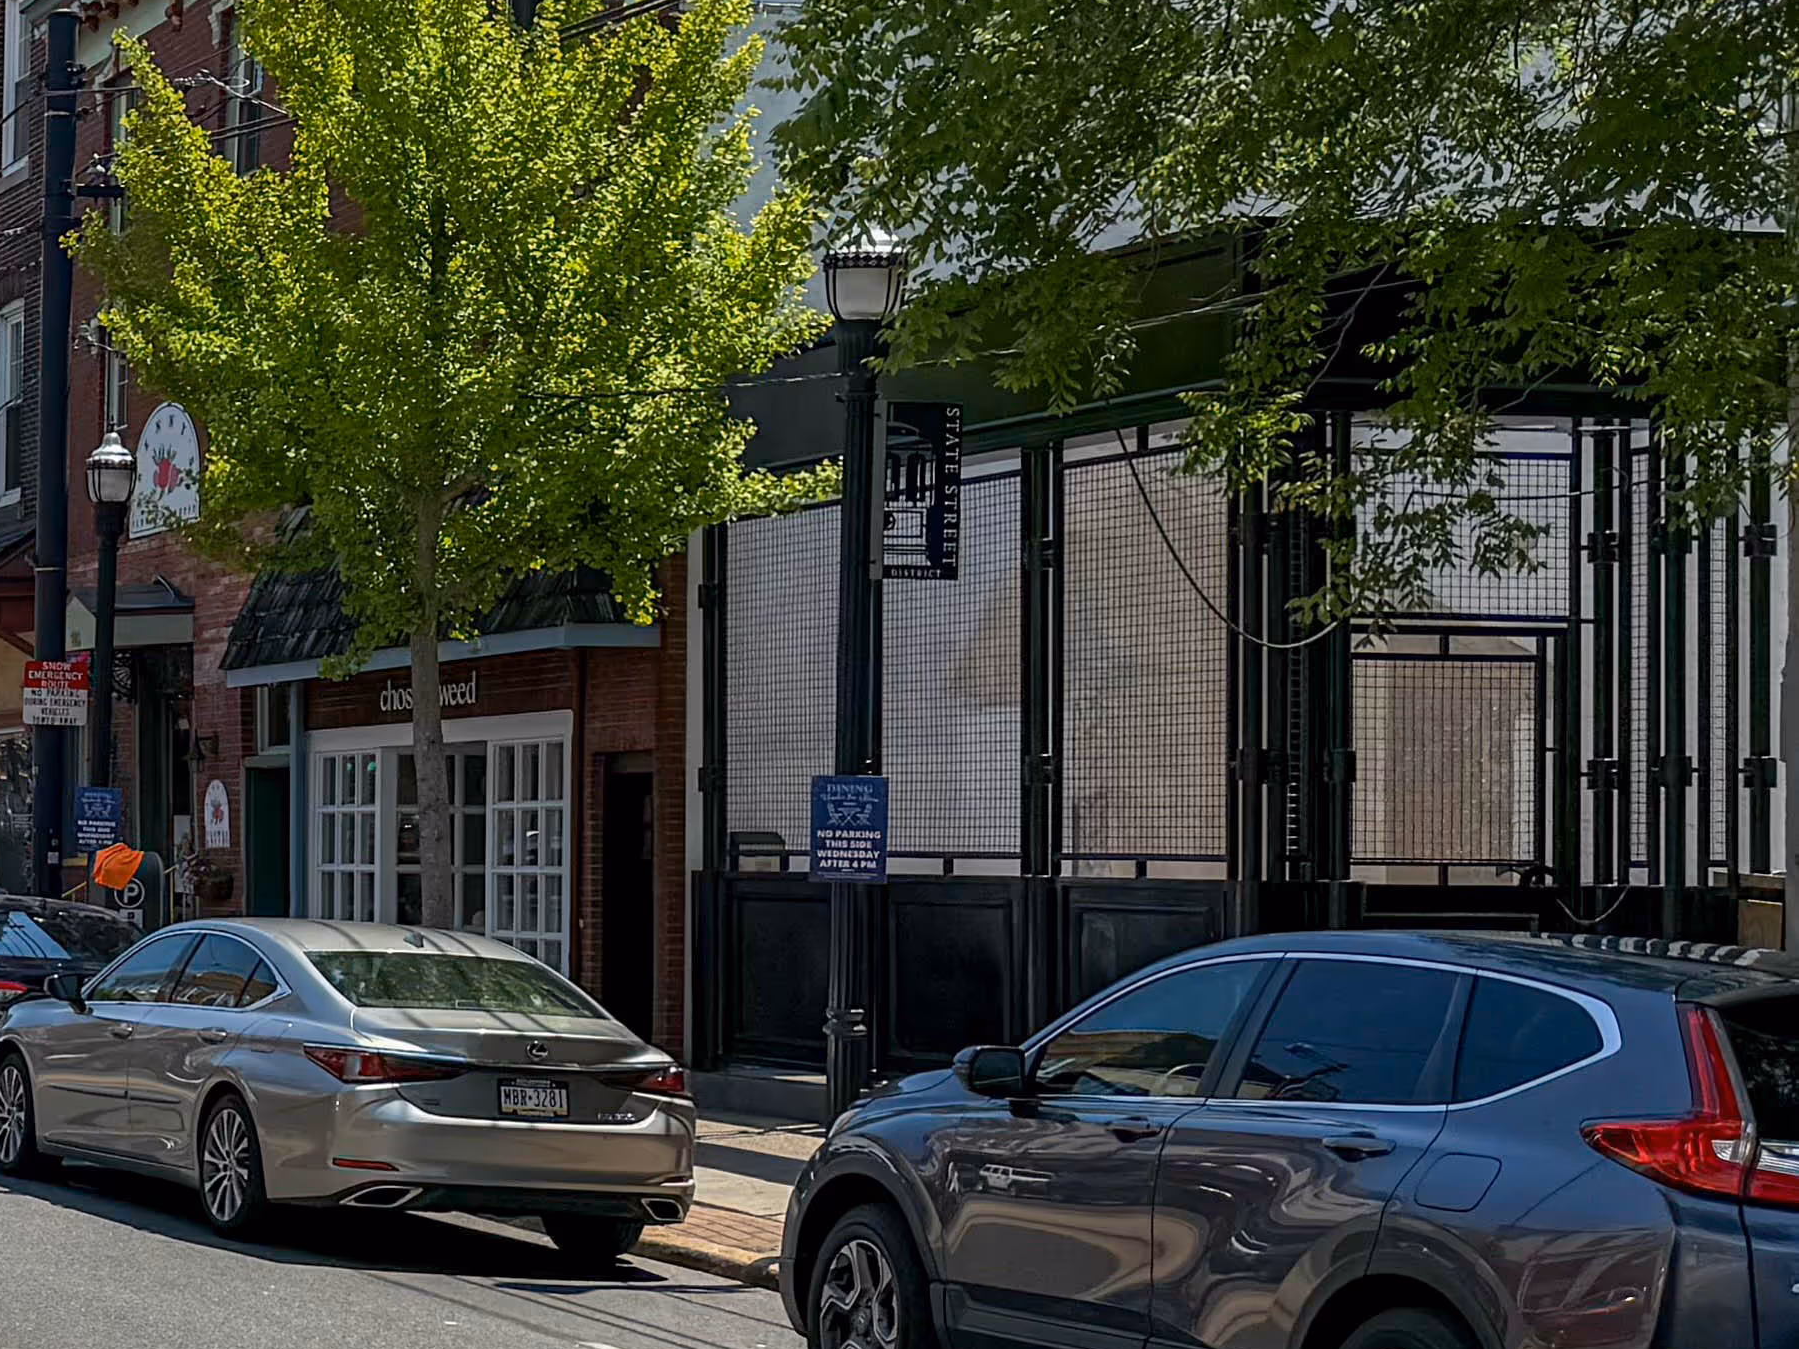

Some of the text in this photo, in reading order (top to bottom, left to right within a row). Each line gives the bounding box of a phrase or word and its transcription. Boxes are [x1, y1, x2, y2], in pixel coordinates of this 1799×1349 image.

[943, 407, 960, 567] STATE STREET
[891, 569, 941, 578] DISTRICT
[42, 661, 72, 671] SNOW
[28, 670, 84, 680] EMERGENCY
[380, 670, 476, 711] chosweed
[817, 829, 881, 839] NO PARKING
[825, 840, 872, 849] THIS SIDE
[817, 849, 880, 859] WEDNESDAY
[819, 859, 877, 869] AFTER 4 PM
